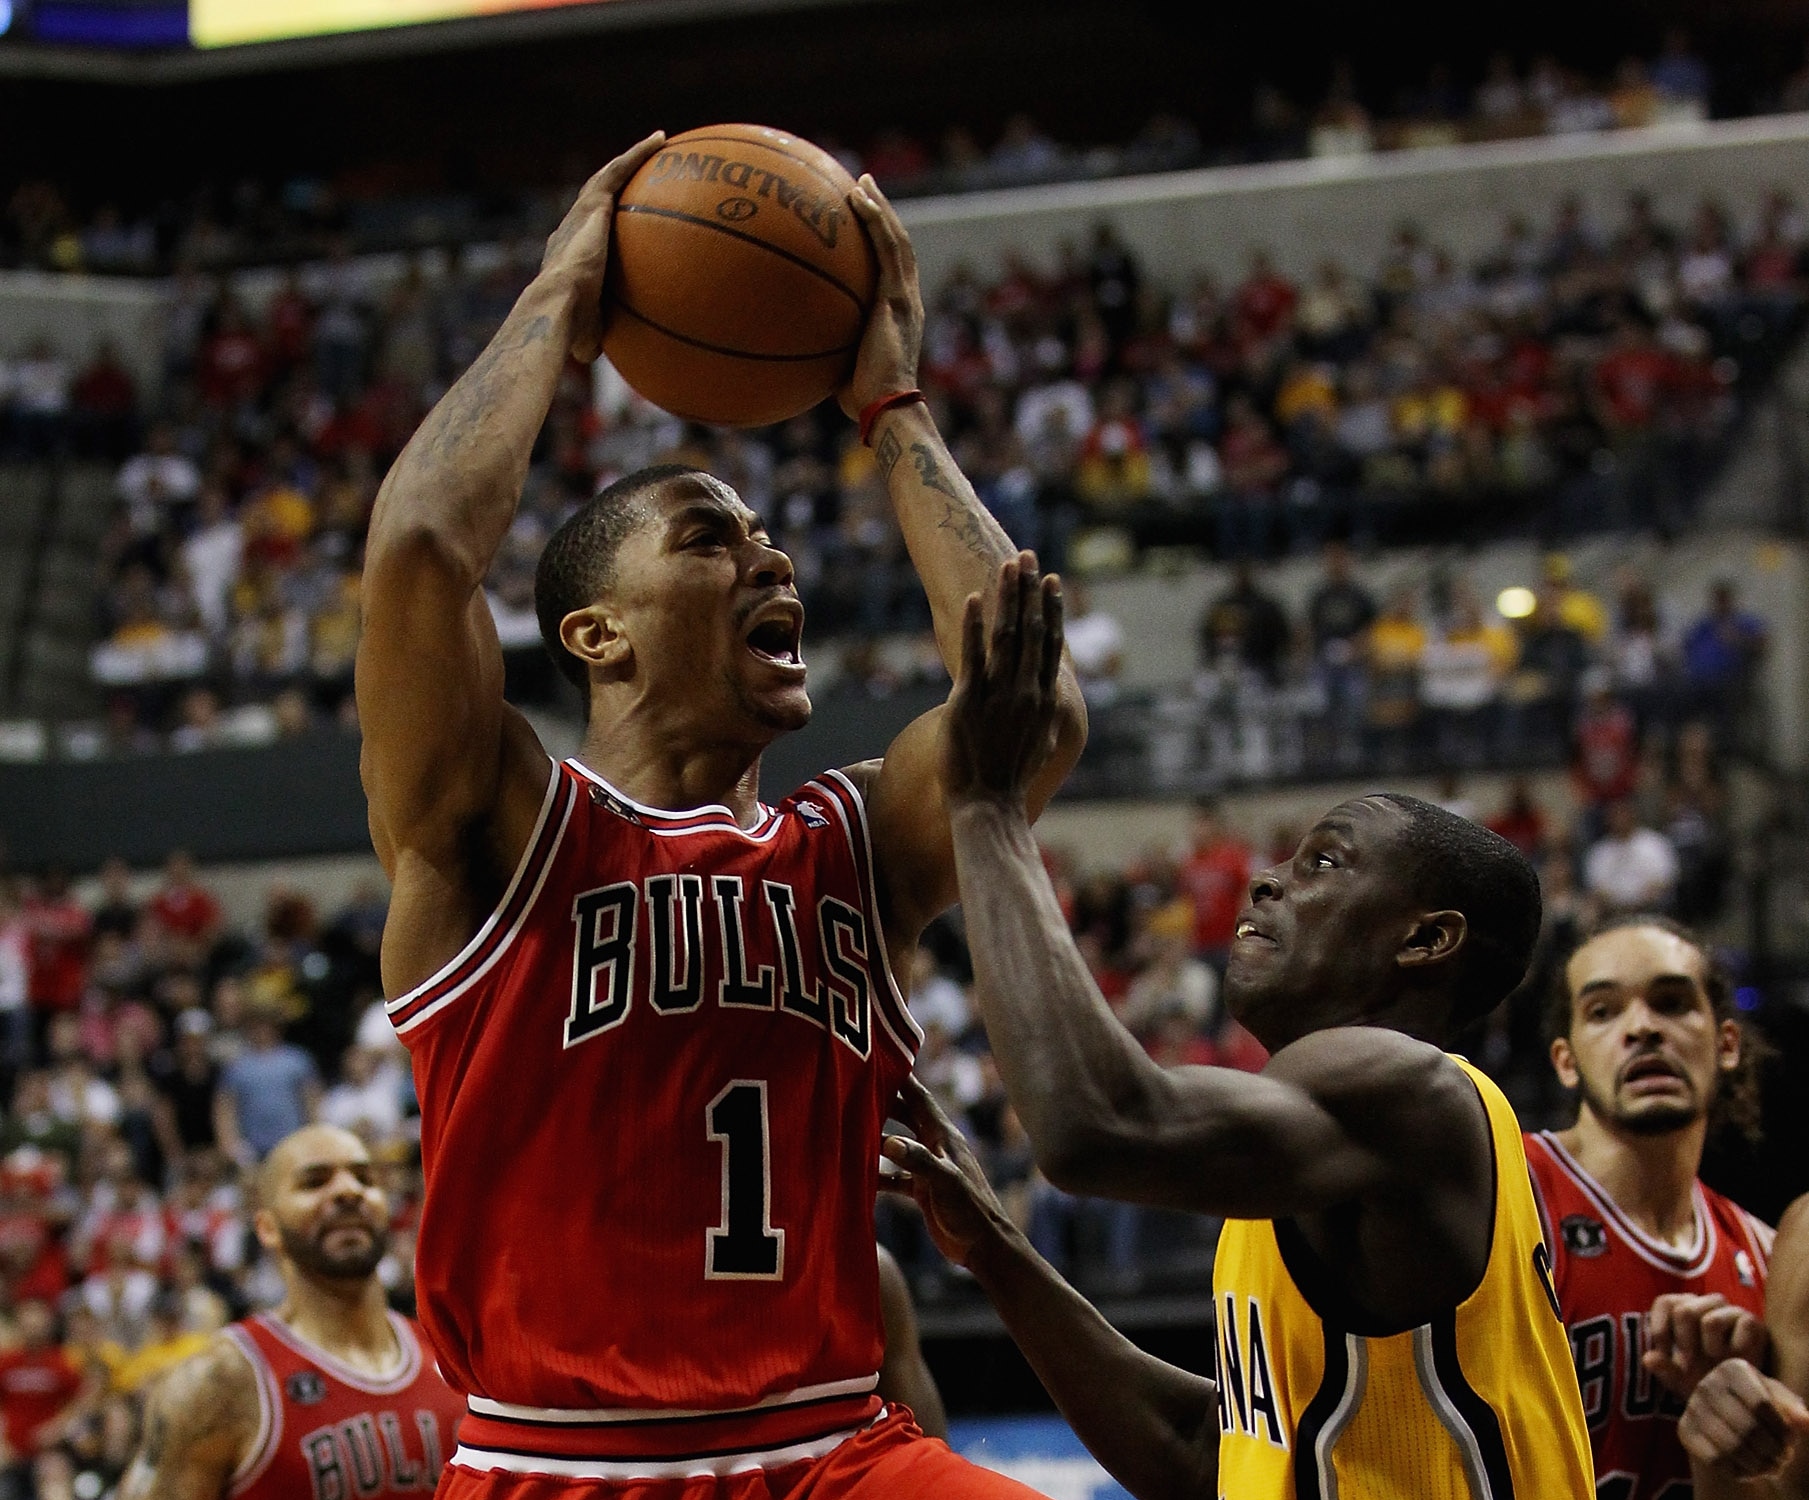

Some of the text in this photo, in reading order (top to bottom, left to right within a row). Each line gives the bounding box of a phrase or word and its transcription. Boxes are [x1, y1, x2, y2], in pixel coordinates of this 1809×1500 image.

[649, 152, 839, 249] SPALDING
[563, 873, 871, 1063] BULLS
[704, 1078, 785, 1282] 1
